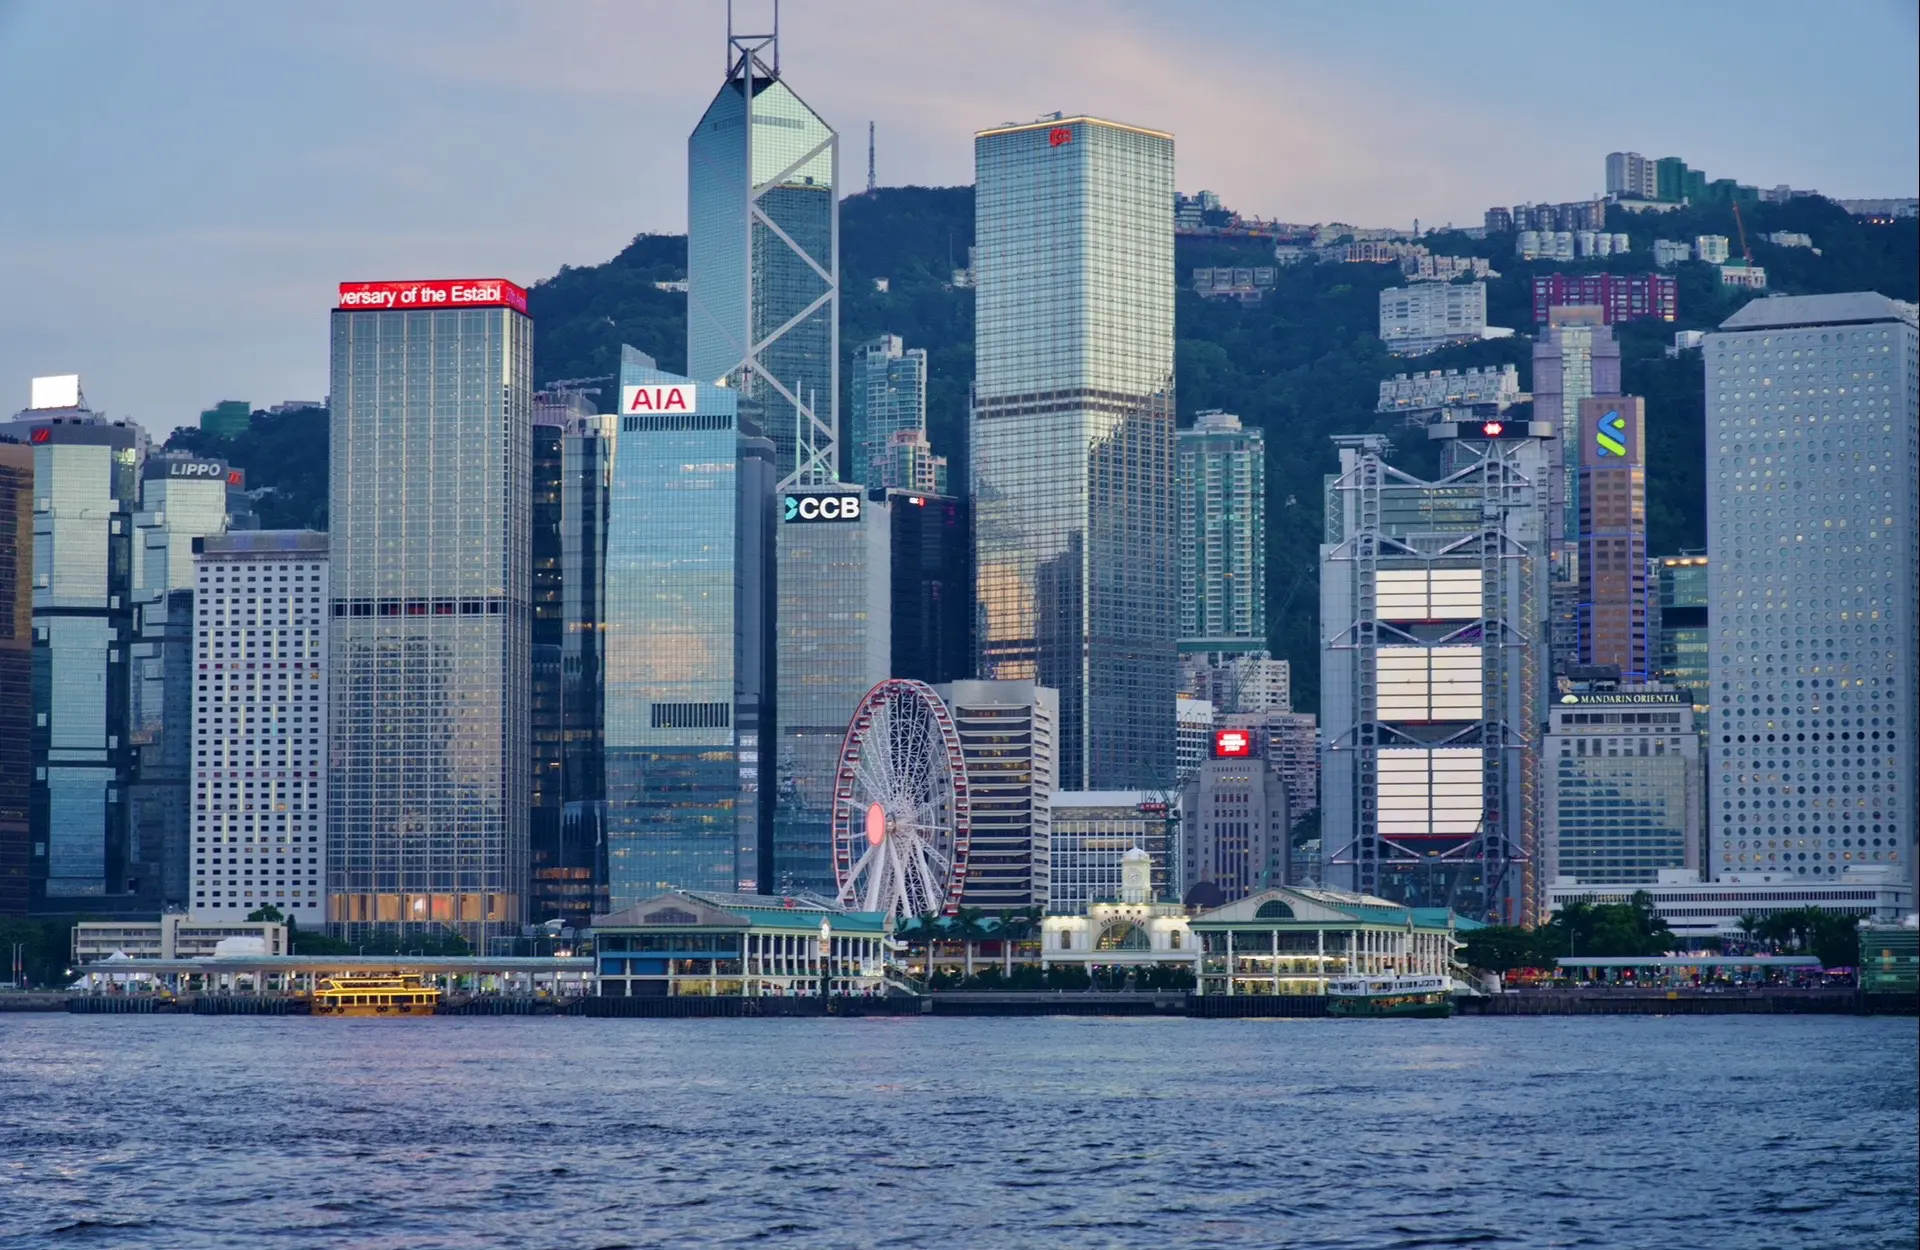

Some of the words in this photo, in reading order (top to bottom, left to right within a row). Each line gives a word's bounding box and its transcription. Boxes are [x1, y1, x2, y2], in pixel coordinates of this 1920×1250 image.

[340, 290, 397, 307] versary
[401, 287, 417, 303] of
[421, 287, 447, 302] the
[451, 286, 501, 302] Establ
[631, 388, 686, 410] AIA
[171, 463, 221, 477] LIPPO
[799, 497, 860, 520] CCB
[1580, 694, 1632, 703] MANDARIN
[1633, 693, 1681, 703] ORIENTAL
